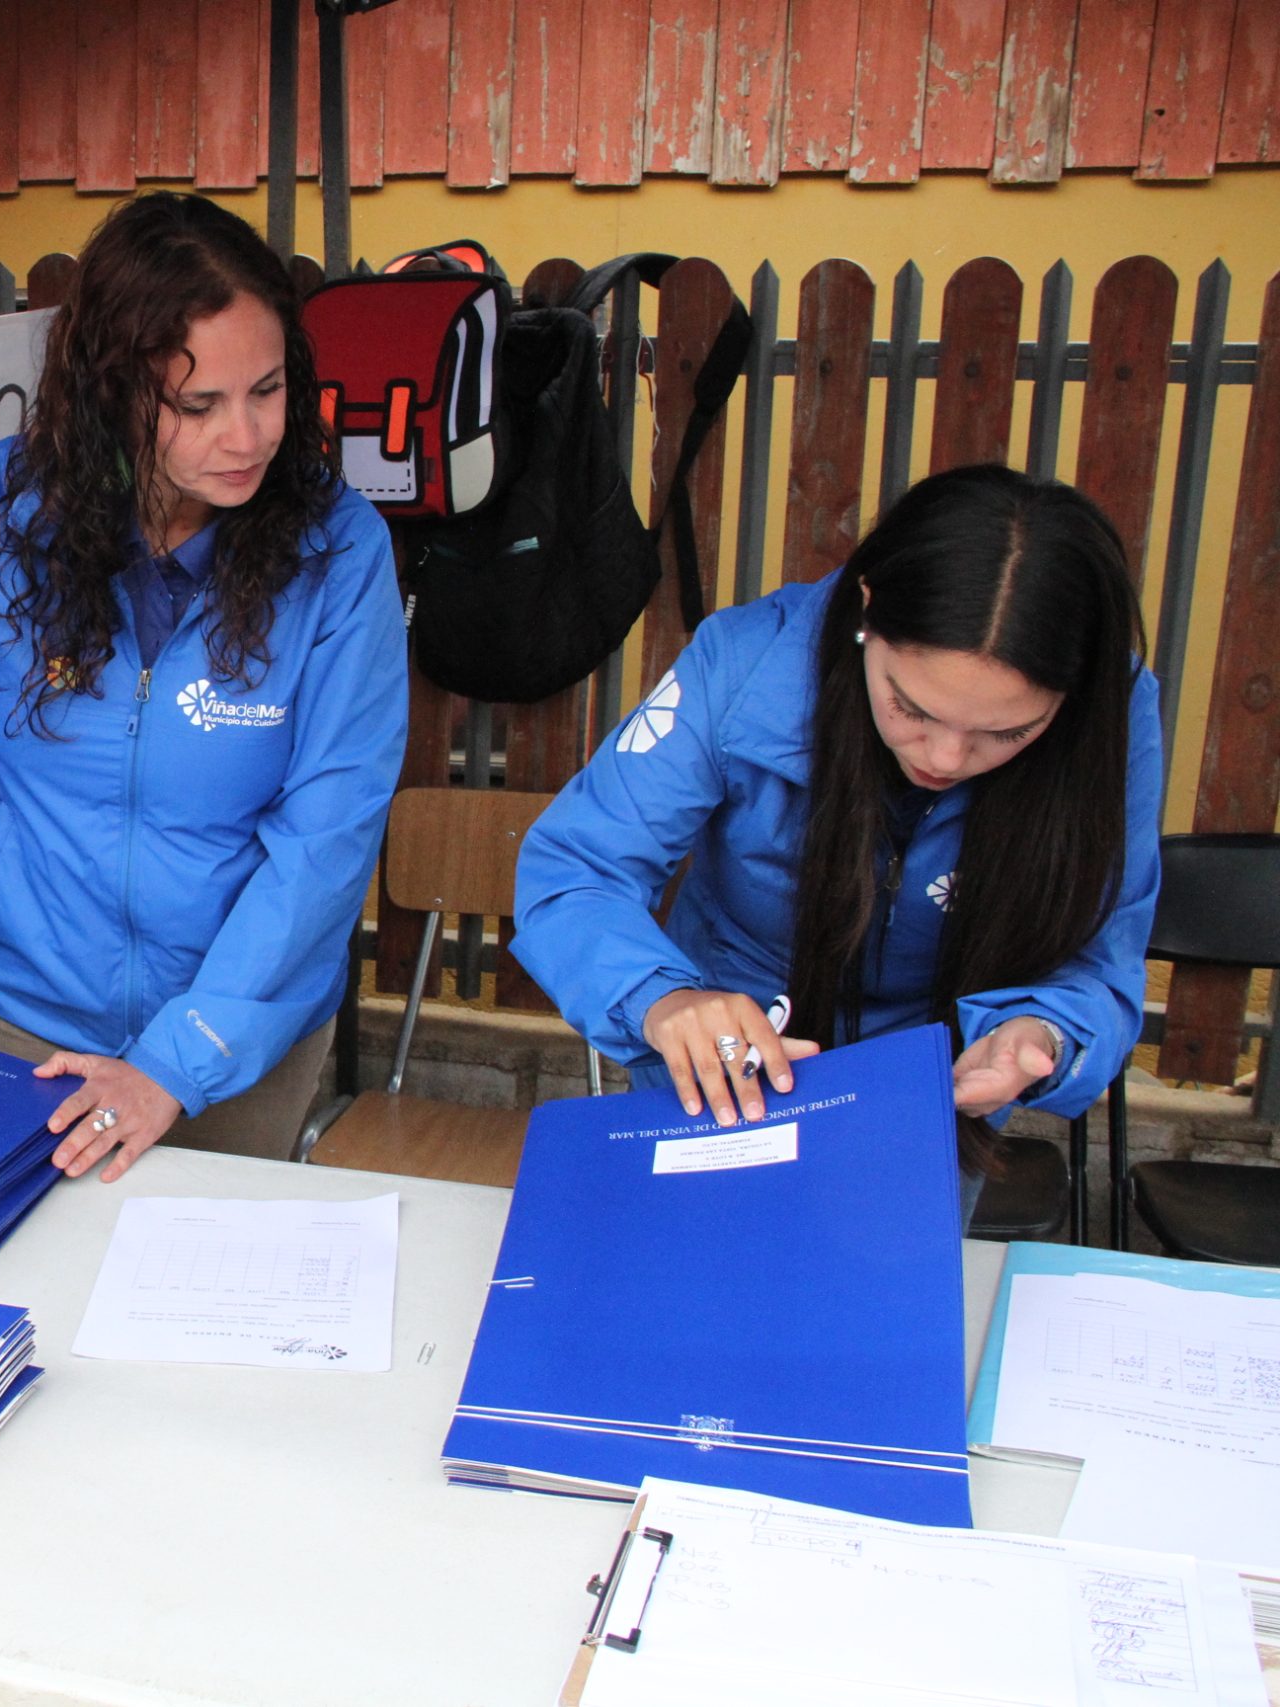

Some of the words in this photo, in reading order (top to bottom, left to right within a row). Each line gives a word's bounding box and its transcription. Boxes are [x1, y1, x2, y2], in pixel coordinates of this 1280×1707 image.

[201, 697, 288, 718] ViñadelMar
[241, 718, 252, 726] de
[808, 1093, 856, 1112] ILUSTRE
[637, 1128, 660, 1138] DEL
[661, 1125, 691, 1137] VIÑA
[693, 1123, 710, 1133] DE
[608, 1131, 635, 1141] MAR
